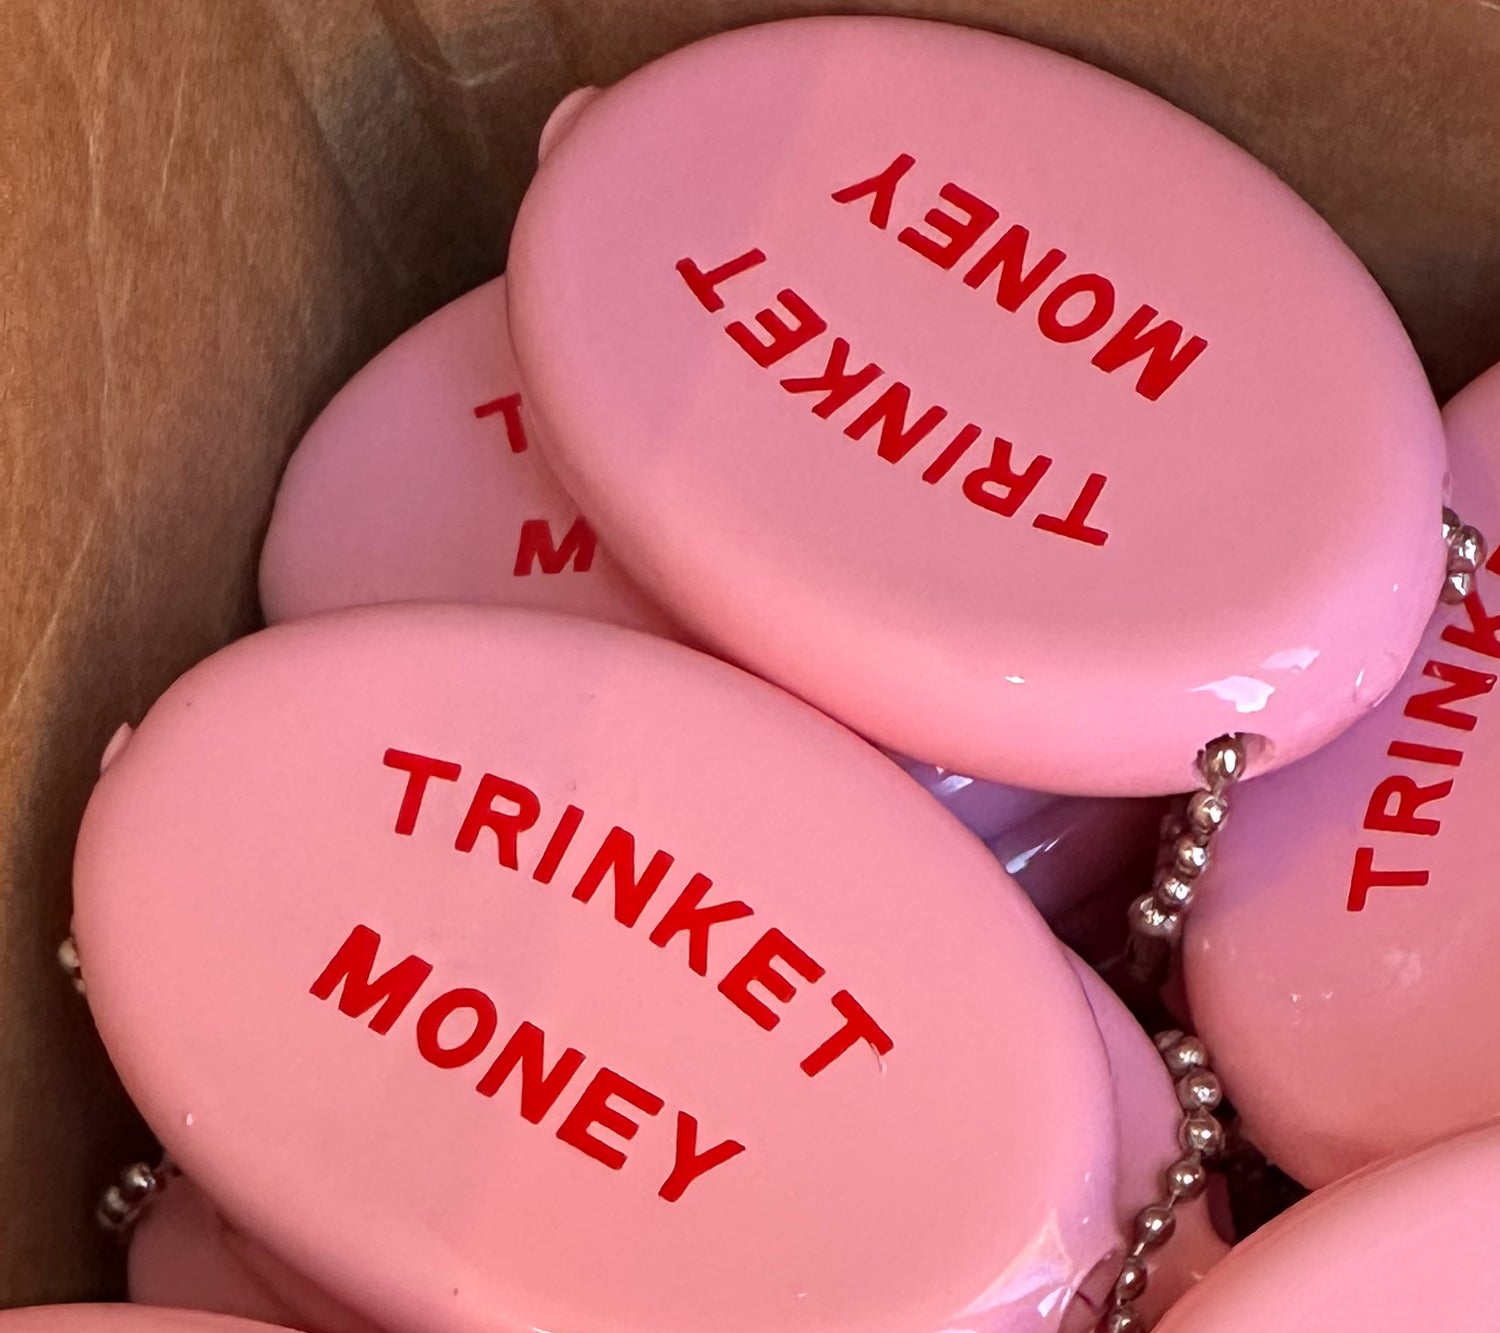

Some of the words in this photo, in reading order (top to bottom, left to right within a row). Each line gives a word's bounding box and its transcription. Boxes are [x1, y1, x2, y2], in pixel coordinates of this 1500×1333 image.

[676, 248, 1108, 545] TRINKET
[831, 154, 1207, 401] MONEY
[383, 748, 894, 1080] TRINKET
[309, 925, 745, 1202] MONEY
